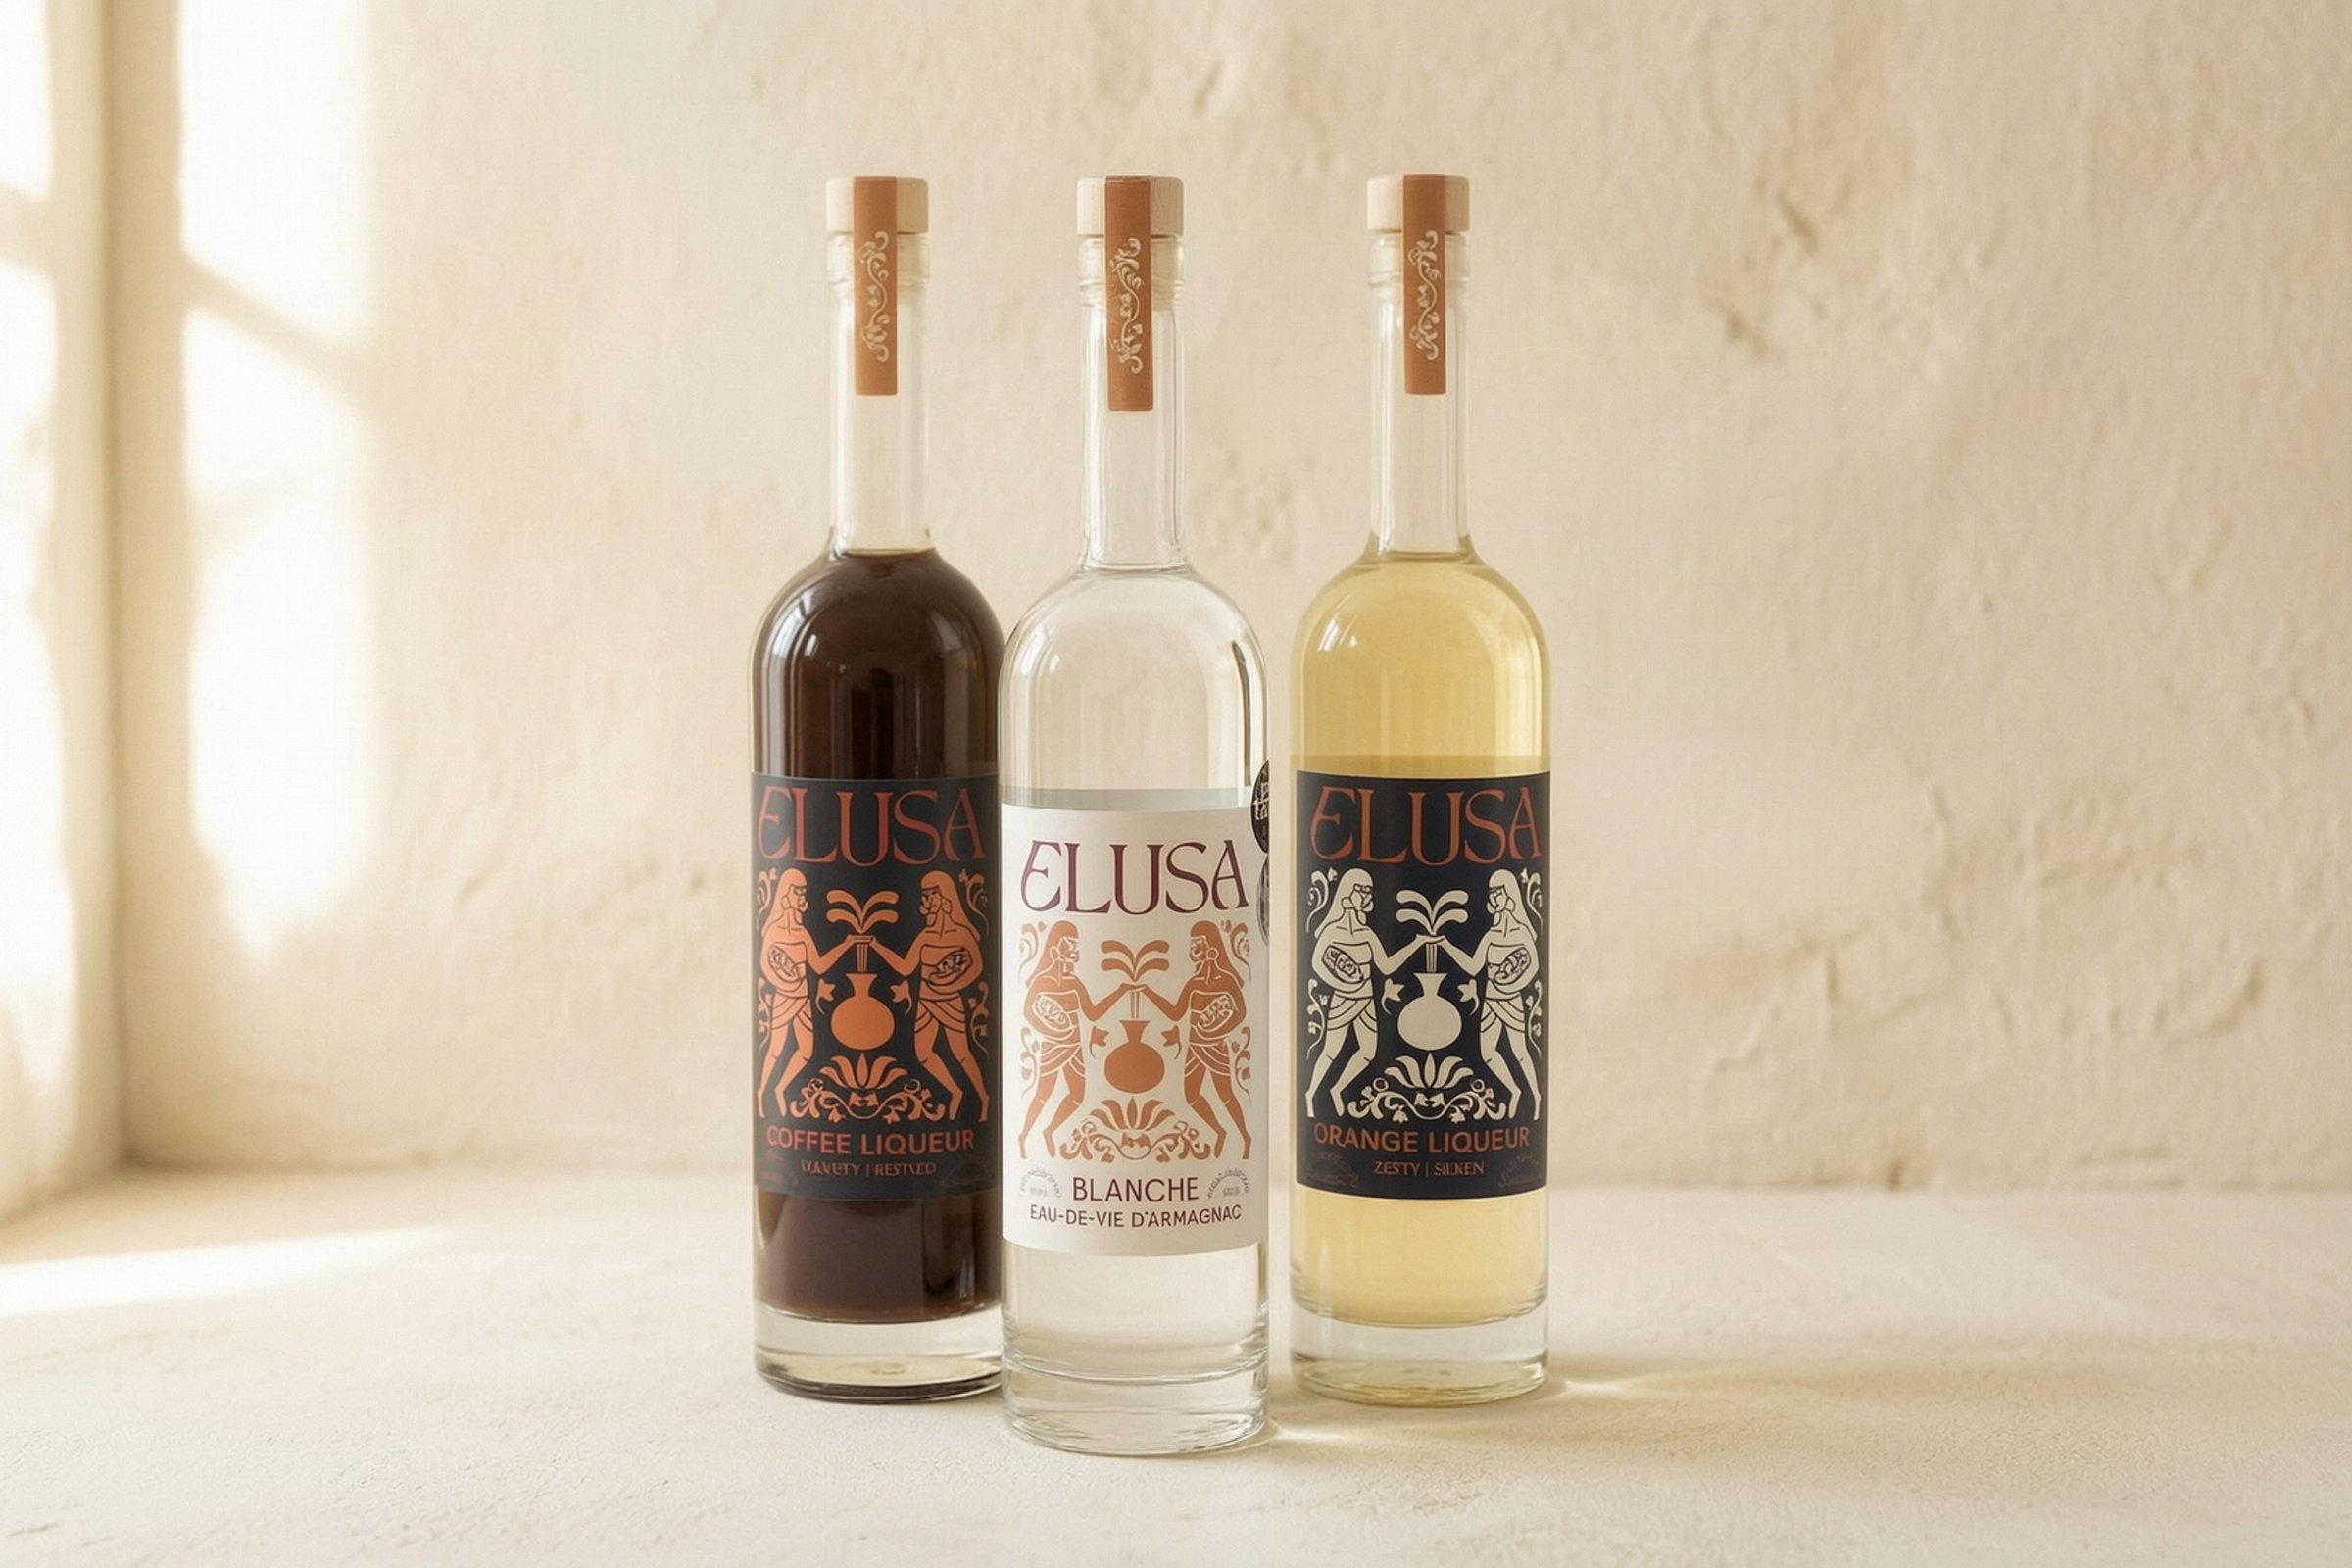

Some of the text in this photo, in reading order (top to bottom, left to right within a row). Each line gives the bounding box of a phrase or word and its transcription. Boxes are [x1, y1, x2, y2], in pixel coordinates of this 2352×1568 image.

[758, 785, 986, 866] ELUSA
[1309, 785, 1543, 866] ELUSA
[1020, 839, 1250, 915] ELUSA
[766, 1125, 975, 1155] COFFEE LIQUEUR
[1313, 1122, 1530, 1153] ORANGE LIQUEUR
[1373, 1160, 1421, 1175] ZESTY
[1072, 1176, 1200, 1202] BLANCHE
[1030, 1204, 1243, 1228] EAU-DE-VIE D'ARMAGNAC
